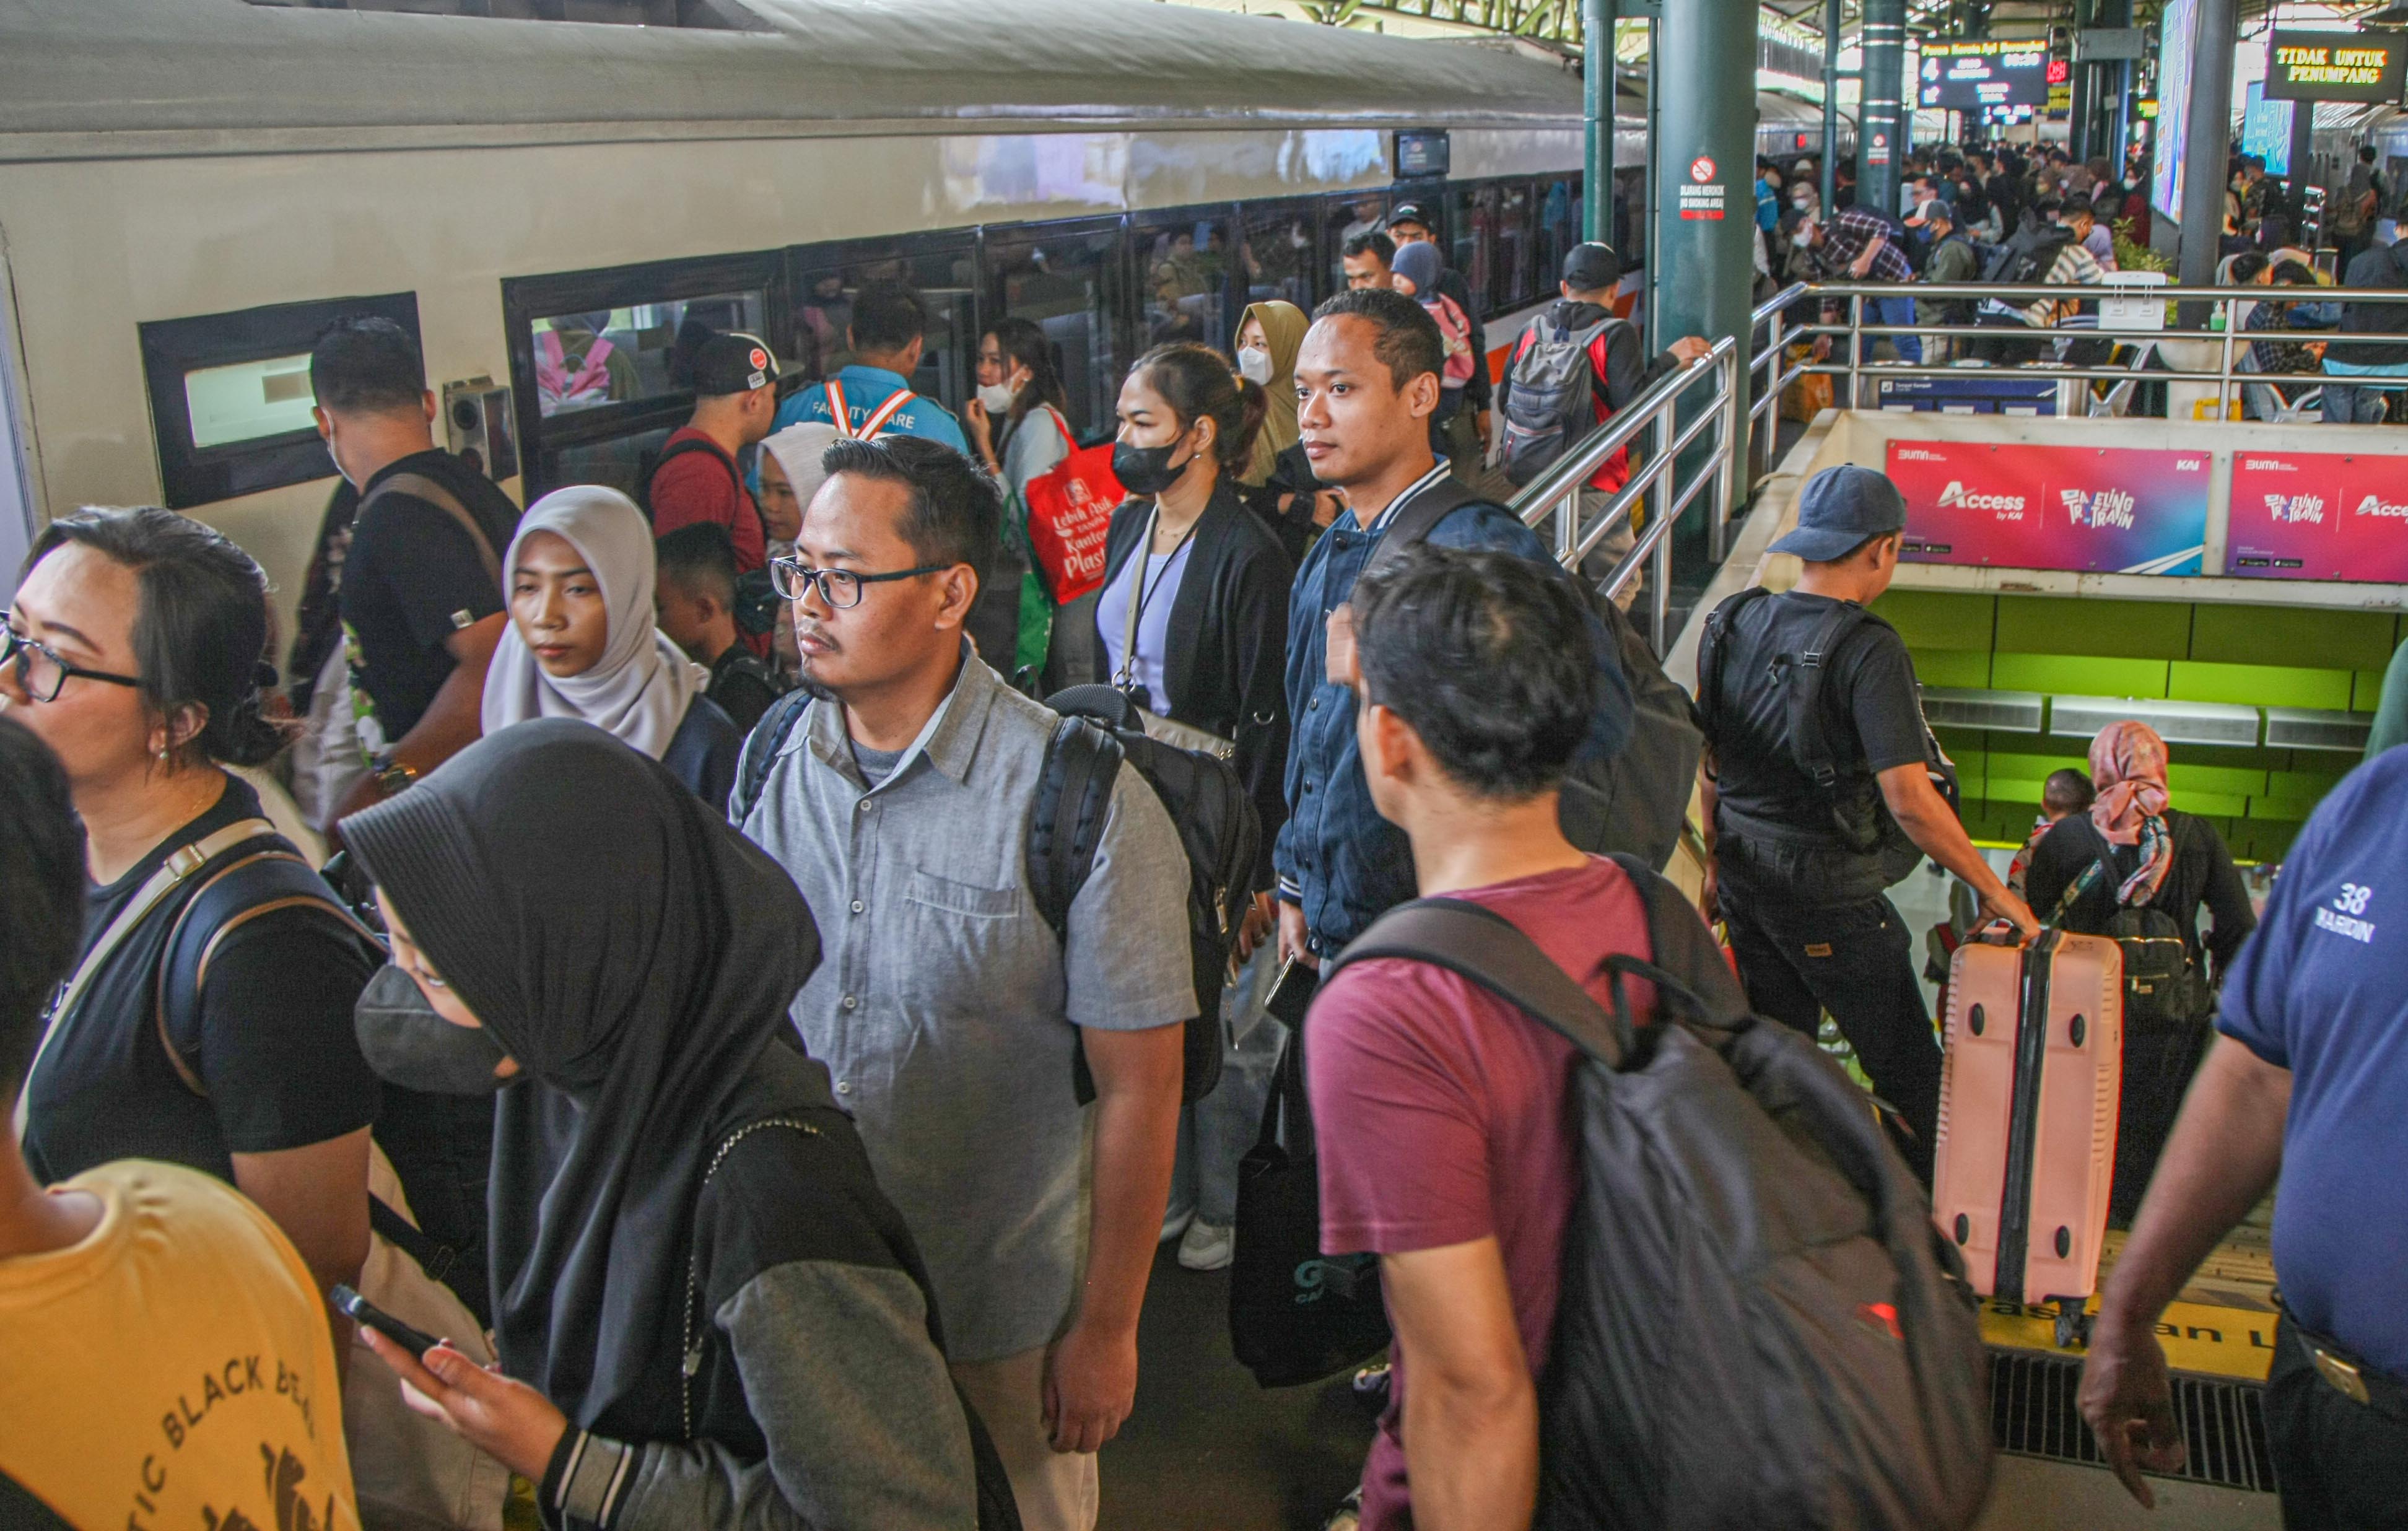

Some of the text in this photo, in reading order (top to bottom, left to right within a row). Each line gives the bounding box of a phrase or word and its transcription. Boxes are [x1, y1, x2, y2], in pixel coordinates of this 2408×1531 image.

[2277, 46, 2388, 68] TIDAK UNTUK
[2288, 65, 2382, 84] PENUMPANG
[886, 412, 915, 429] ARE
[2176, 460, 2201, 471] KAI
[1937, 481, 2026, 511] Access
[1052, 496, 1115, 530] Lebih Asik
[2007, 512, 2023, 520] KAI
[2333, 883, 2372, 915] 38
[162, 1355, 264, 1450] BLACK
